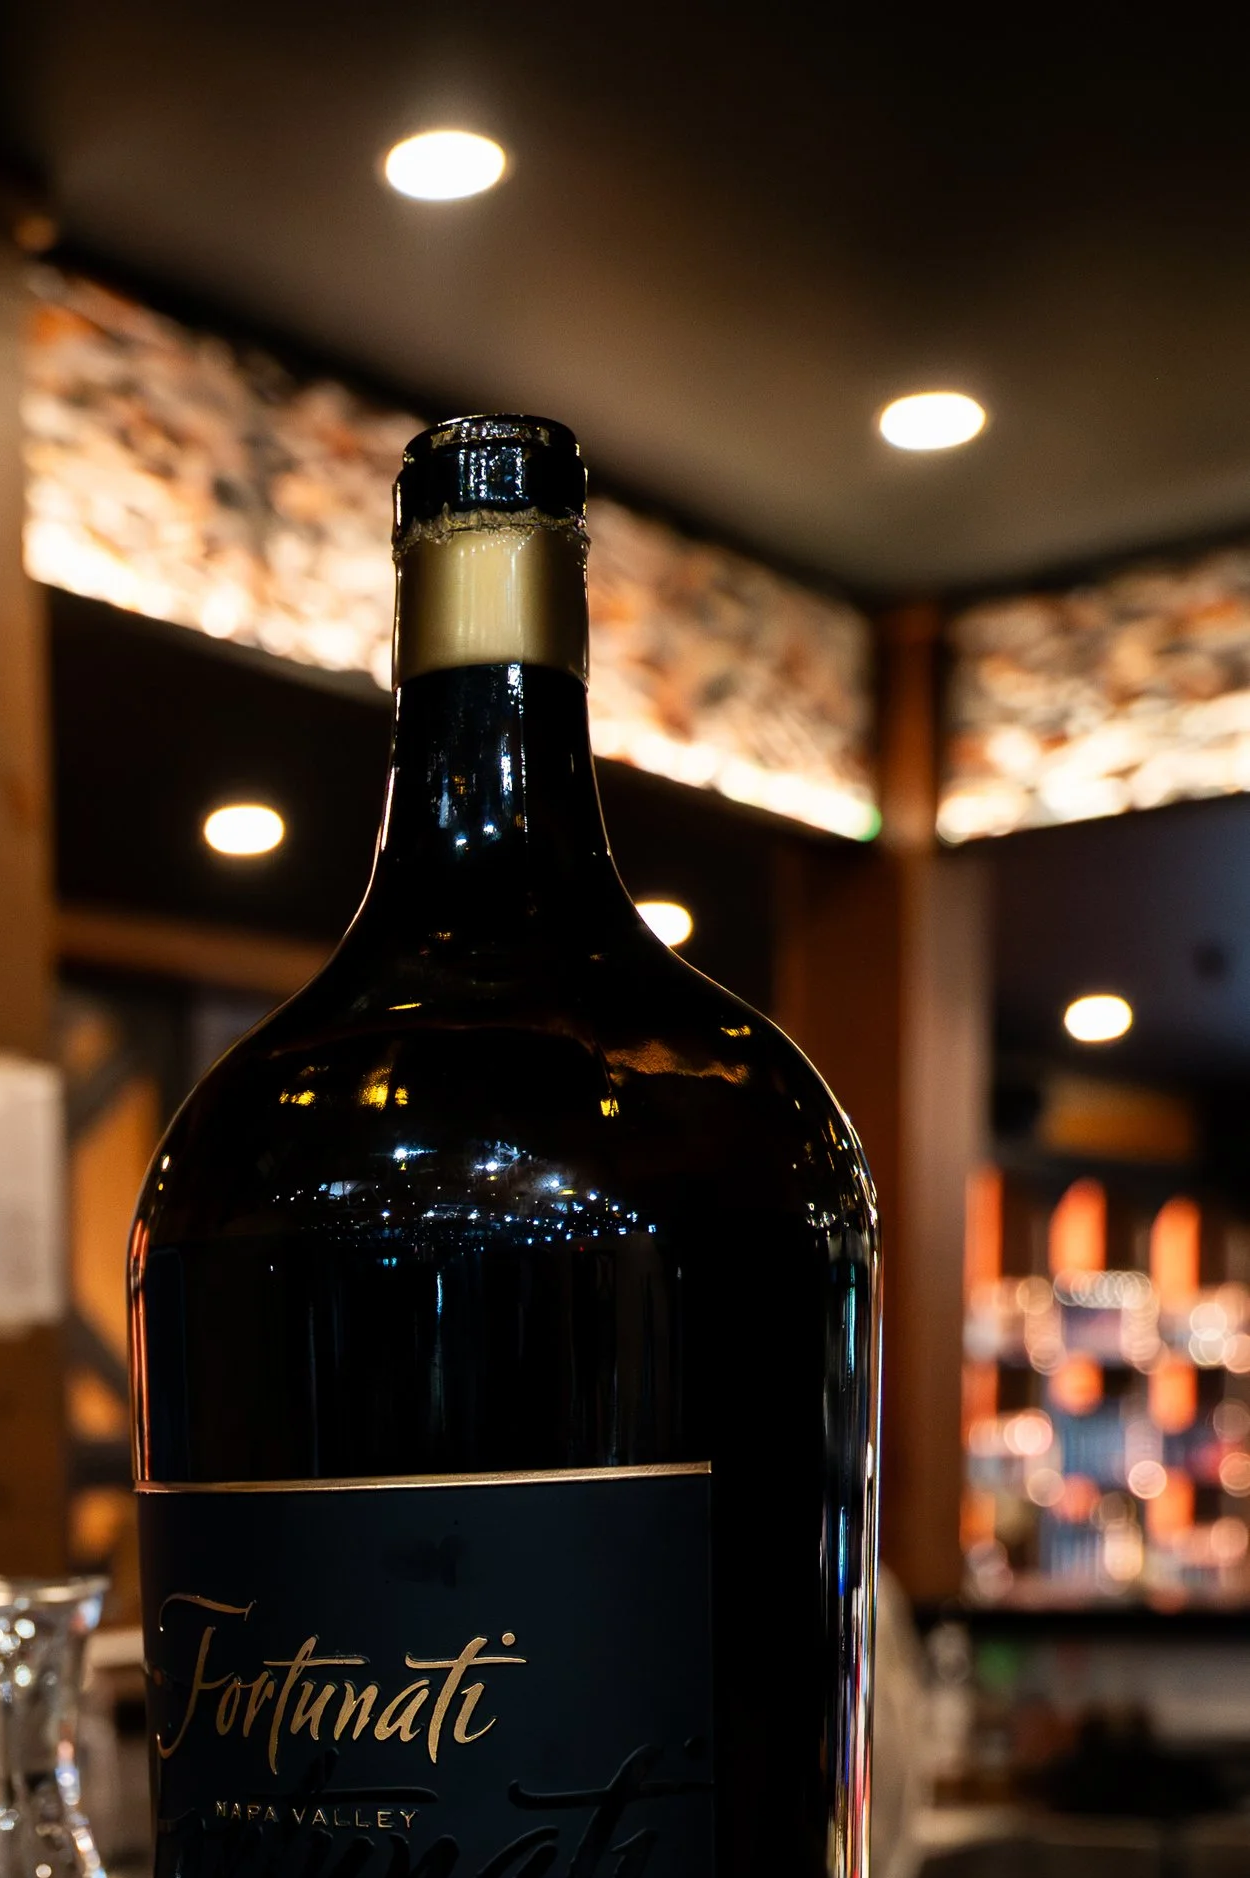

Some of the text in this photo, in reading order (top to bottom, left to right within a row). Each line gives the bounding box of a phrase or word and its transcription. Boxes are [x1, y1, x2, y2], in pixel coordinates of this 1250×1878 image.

[156, 1592, 527, 1775] Fortunati
[216, 1801, 419, 1829] NAPA VALLEY
